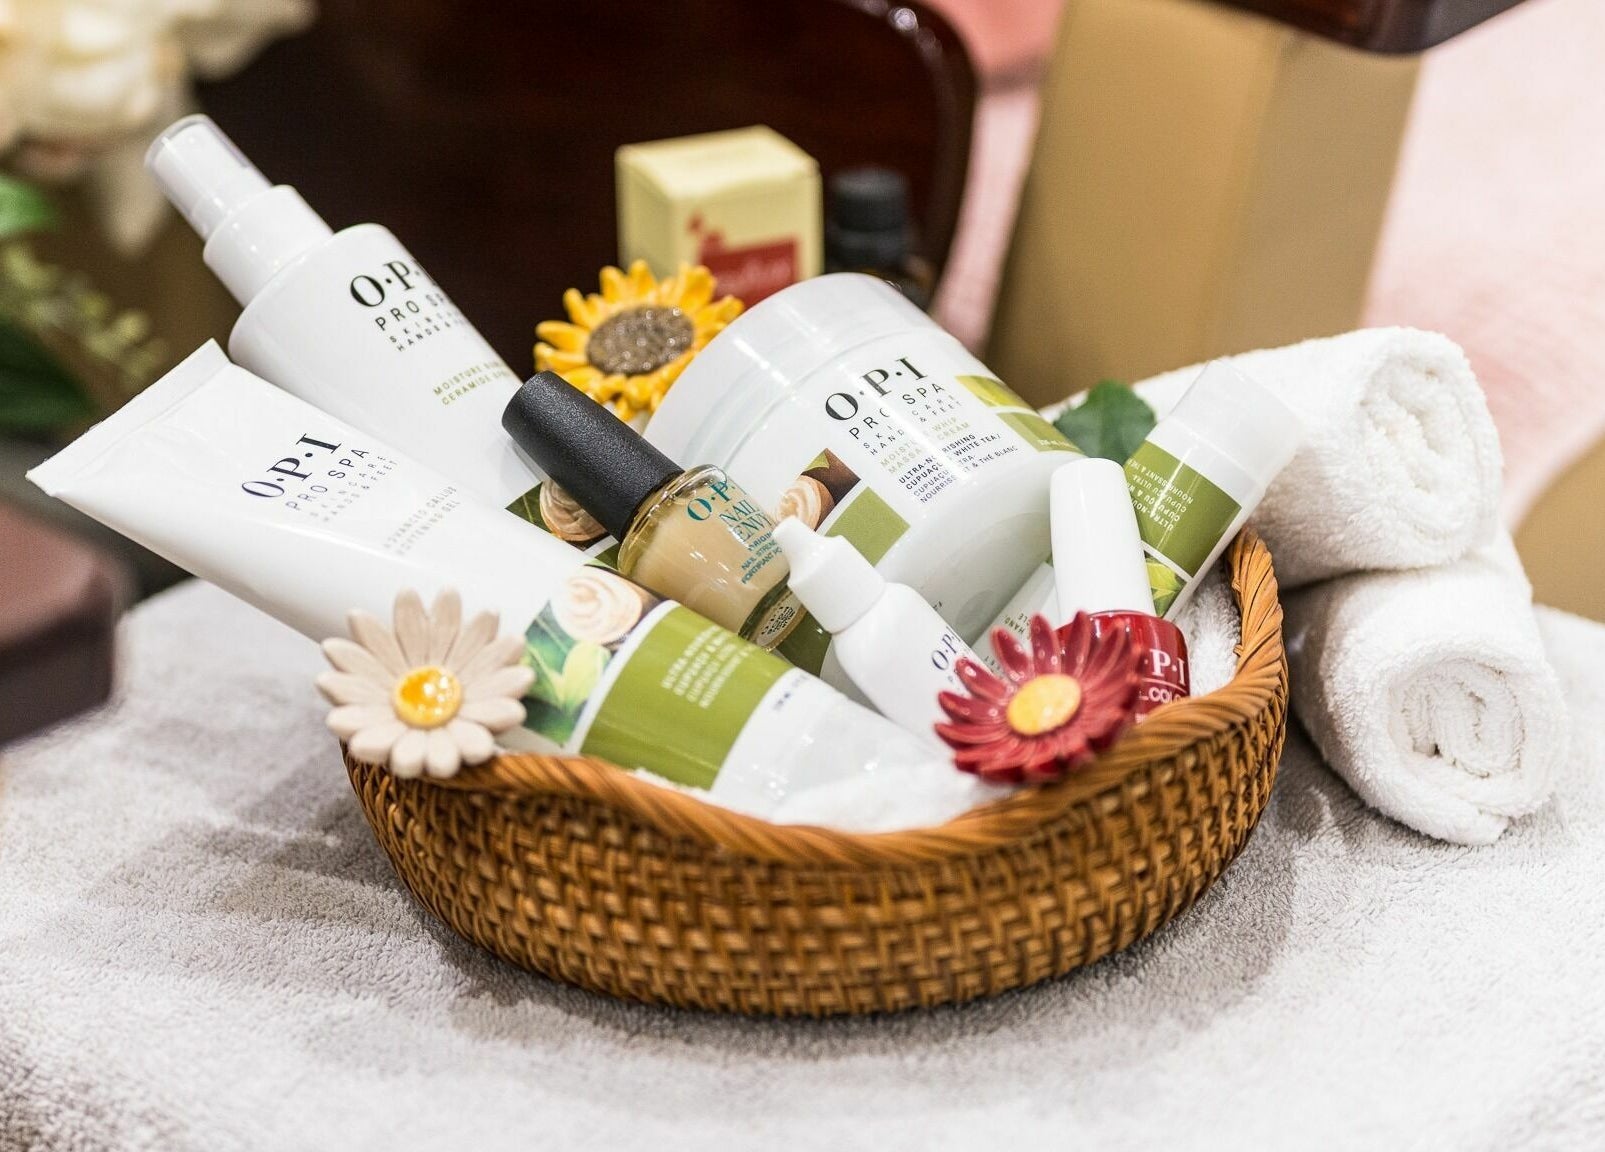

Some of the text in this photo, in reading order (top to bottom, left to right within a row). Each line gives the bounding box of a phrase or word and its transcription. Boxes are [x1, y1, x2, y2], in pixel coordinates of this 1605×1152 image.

[350, 260, 426, 307] O·P·
[375, 300, 420, 331] PRO
[902, 382, 945, 405] SPA
[863, 425, 893, 448] SKI
[931, 417, 958, 432] WHIP
[870, 429, 905, 456] HAND
[888, 421, 970, 475] MASSA CREAM
[953, 442, 981, 457] WHITE
[285, 448, 369, 511] PRO SPA
[732, 511, 777, 544] ENVY
